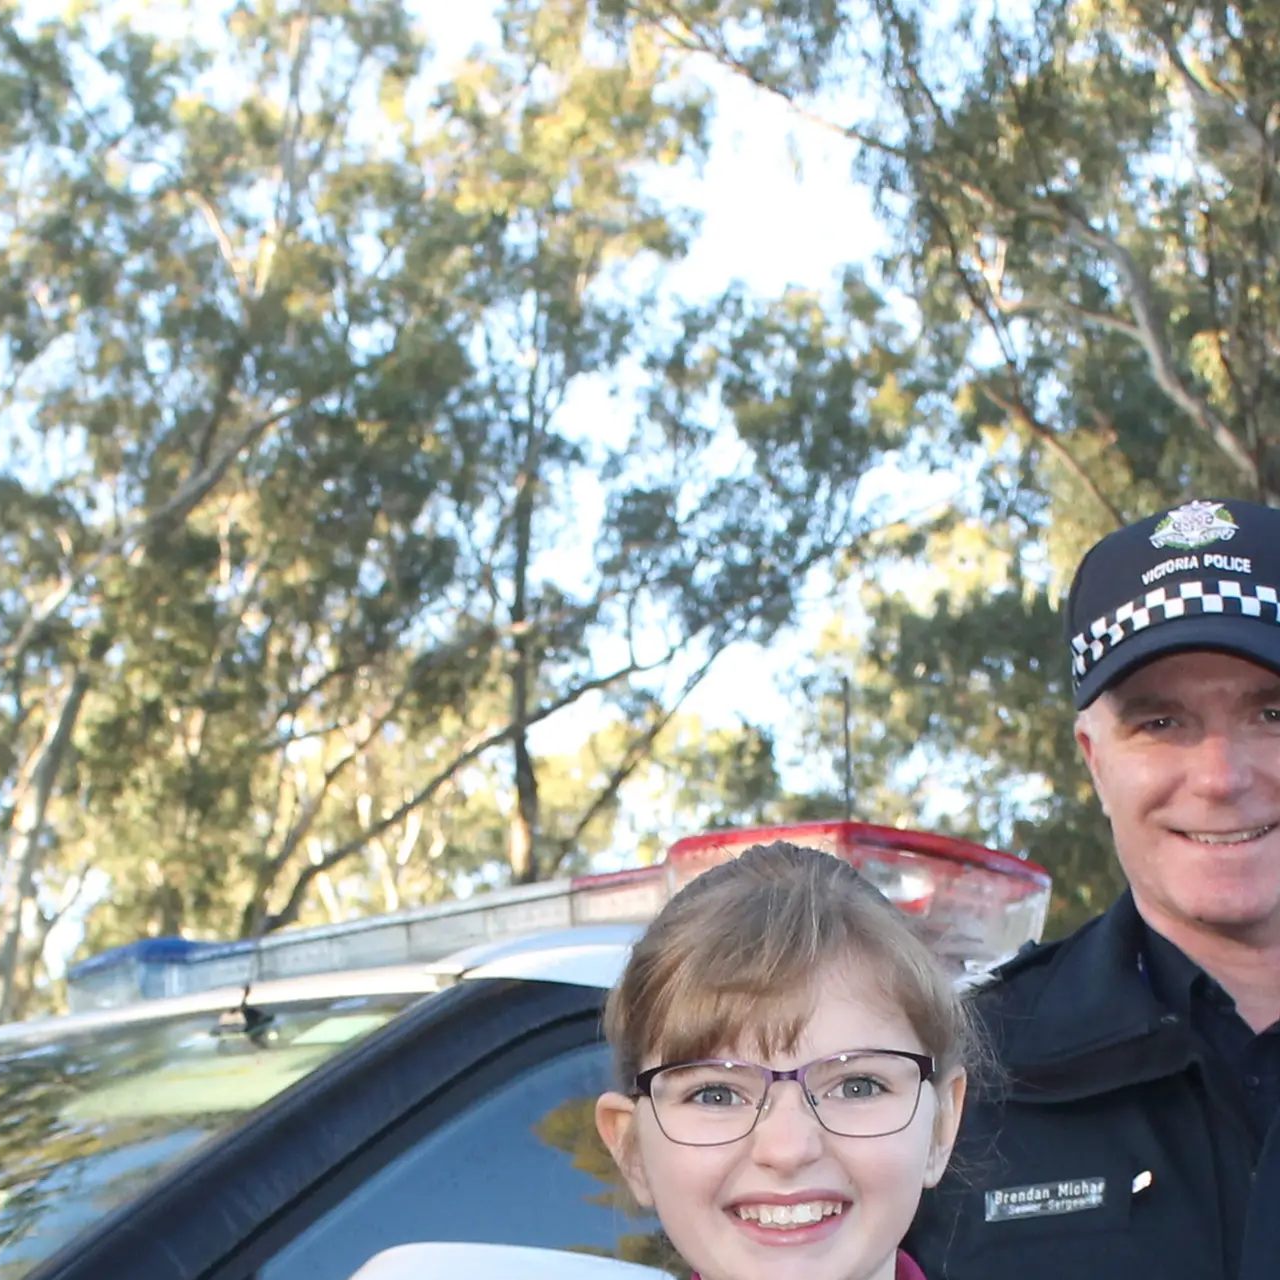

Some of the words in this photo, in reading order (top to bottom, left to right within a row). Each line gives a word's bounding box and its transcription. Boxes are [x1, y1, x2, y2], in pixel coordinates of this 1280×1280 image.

[1141, 555, 1199, 585] VICTORIA
[1203, 553, 1252, 574] POLICE
[994, 1187, 1050, 1205] Brendan
